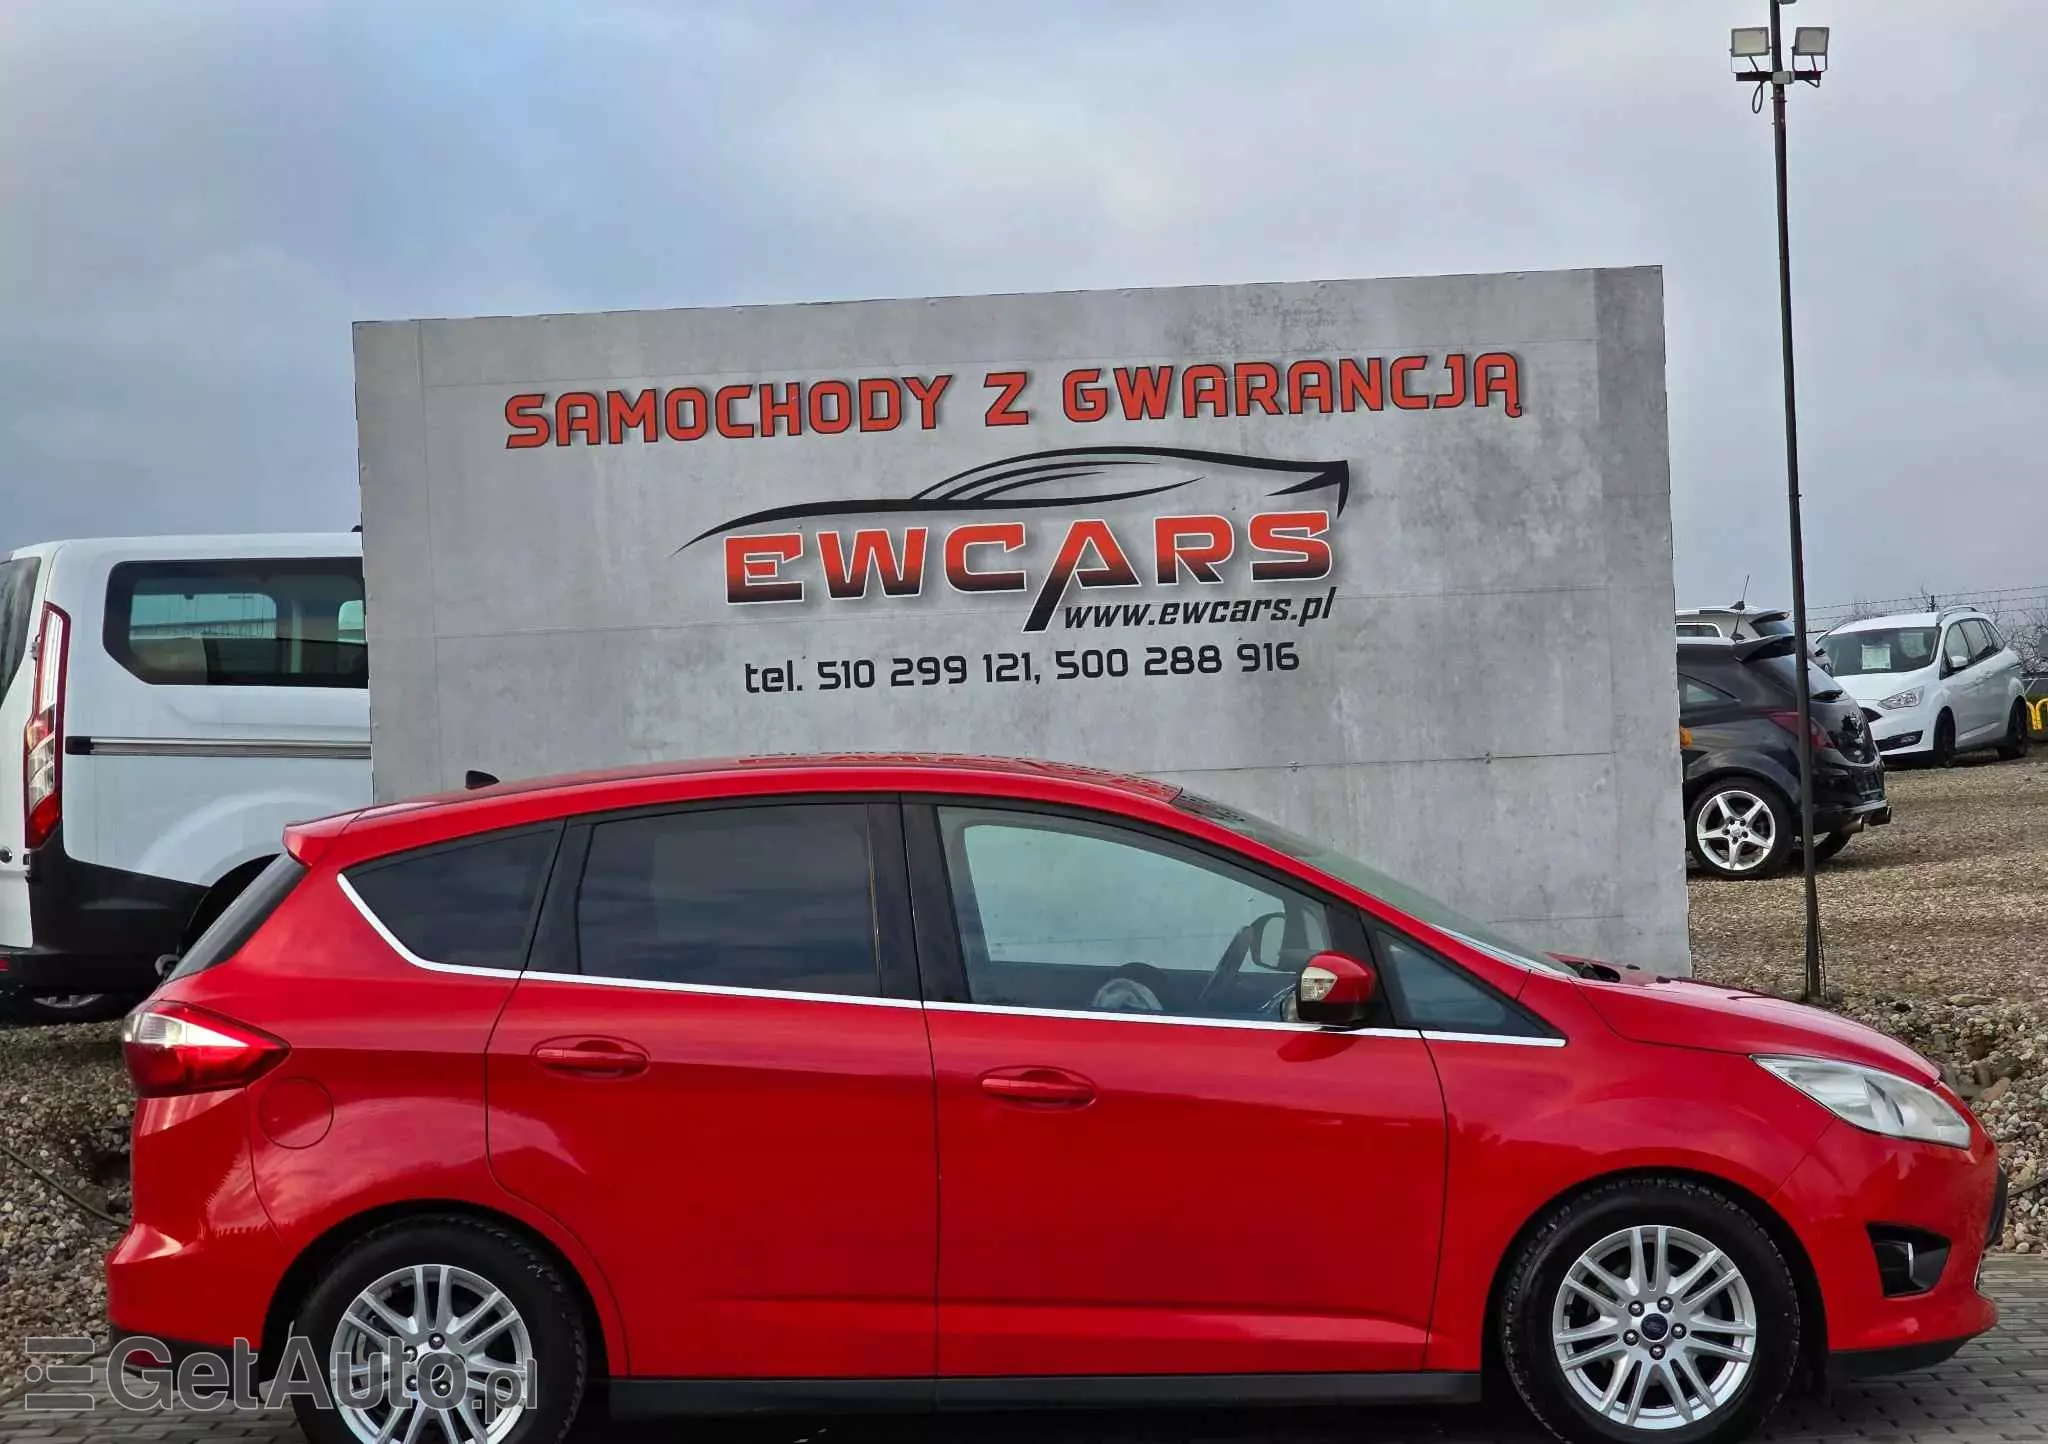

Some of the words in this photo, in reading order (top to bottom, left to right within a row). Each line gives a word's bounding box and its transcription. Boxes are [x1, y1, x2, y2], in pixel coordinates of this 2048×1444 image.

[505, 374, 953, 450] SAMOCHODY
[984, 371, 1030, 427] Z
[1062, 352, 1523, 422] GWARANCJĄ
[723, 510, 1334, 632] EWCARS
[1064, 586, 1337, 629] www.ewcars.pl
[745, 660, 803, 693] tel.
[817, 659, 875, 692] 510
[890, 655, 968, 688] 299
[983, 652, 1041, 685] 121,
[1055, 648, 1129, 681] 500
[1144, 645, 1223, 677] 288
[1237, 641, 1300, 674] 916
